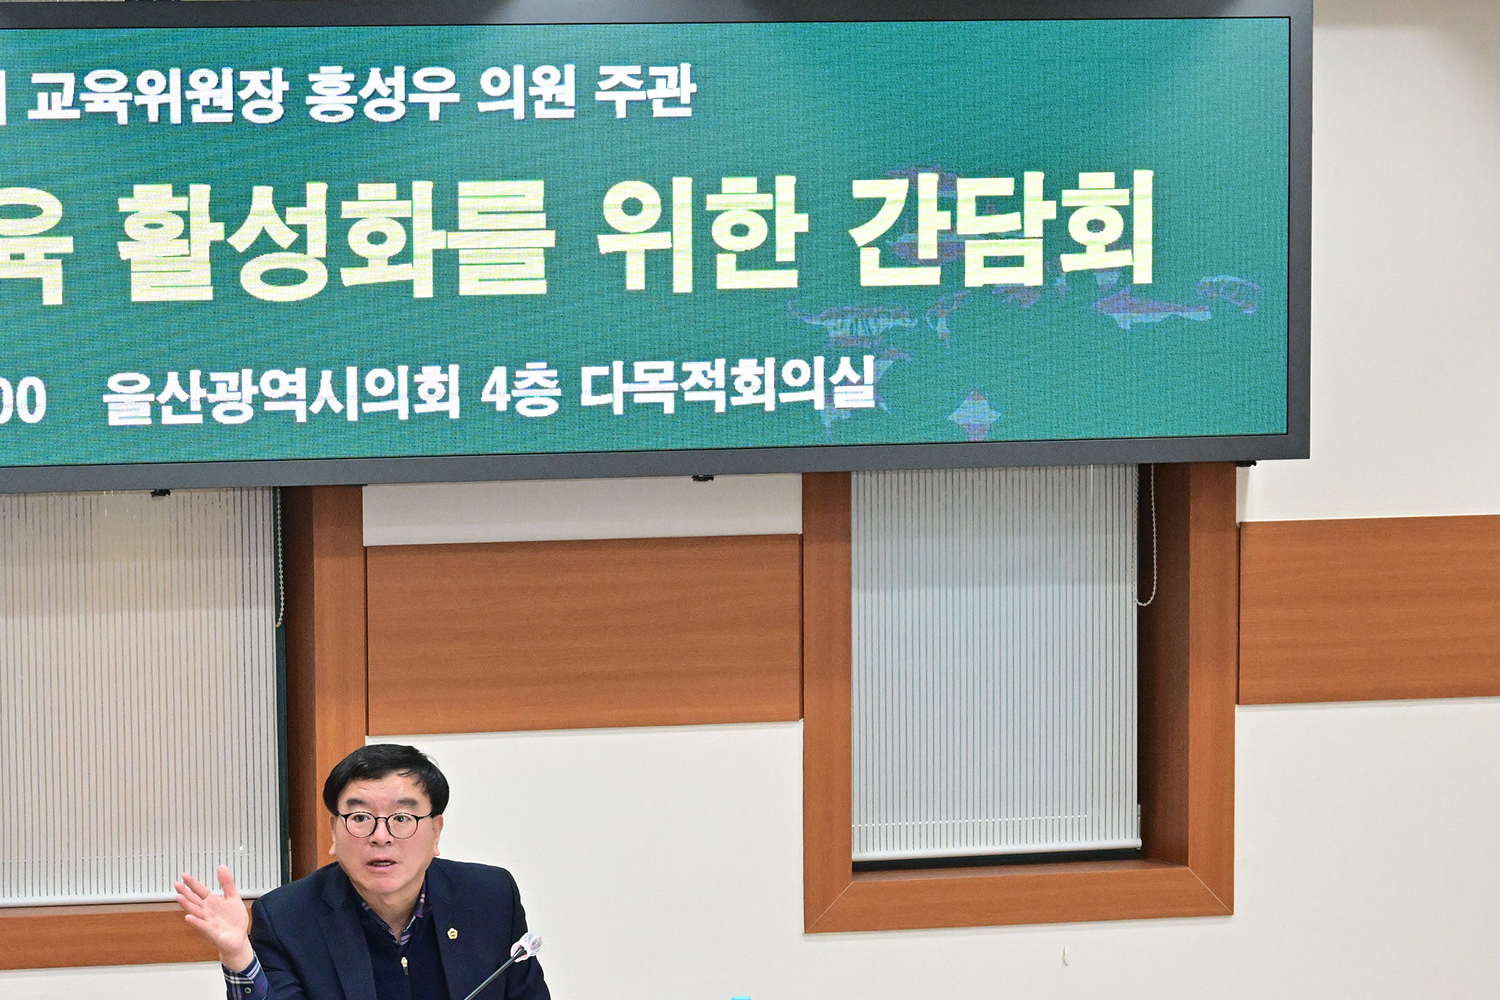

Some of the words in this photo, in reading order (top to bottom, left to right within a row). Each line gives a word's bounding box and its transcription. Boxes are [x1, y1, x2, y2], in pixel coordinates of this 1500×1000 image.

[28, 67, 289, 125] 교육위원장
[305, 65, 461, 123] 홍성우
[478, 64, 576, 120] 의원
[594, 63, 697, 119] 주관
[117, 180, 556, 302] 활성화를
[597, 176, 809, 293] 위한
[849, 169, 1154, 288] 간담회
[102, 364, 460, 426] 울산광역시의회
[481, 362, 562, 418] 4층
[580, 355, 876, 415] 다목적회의실
